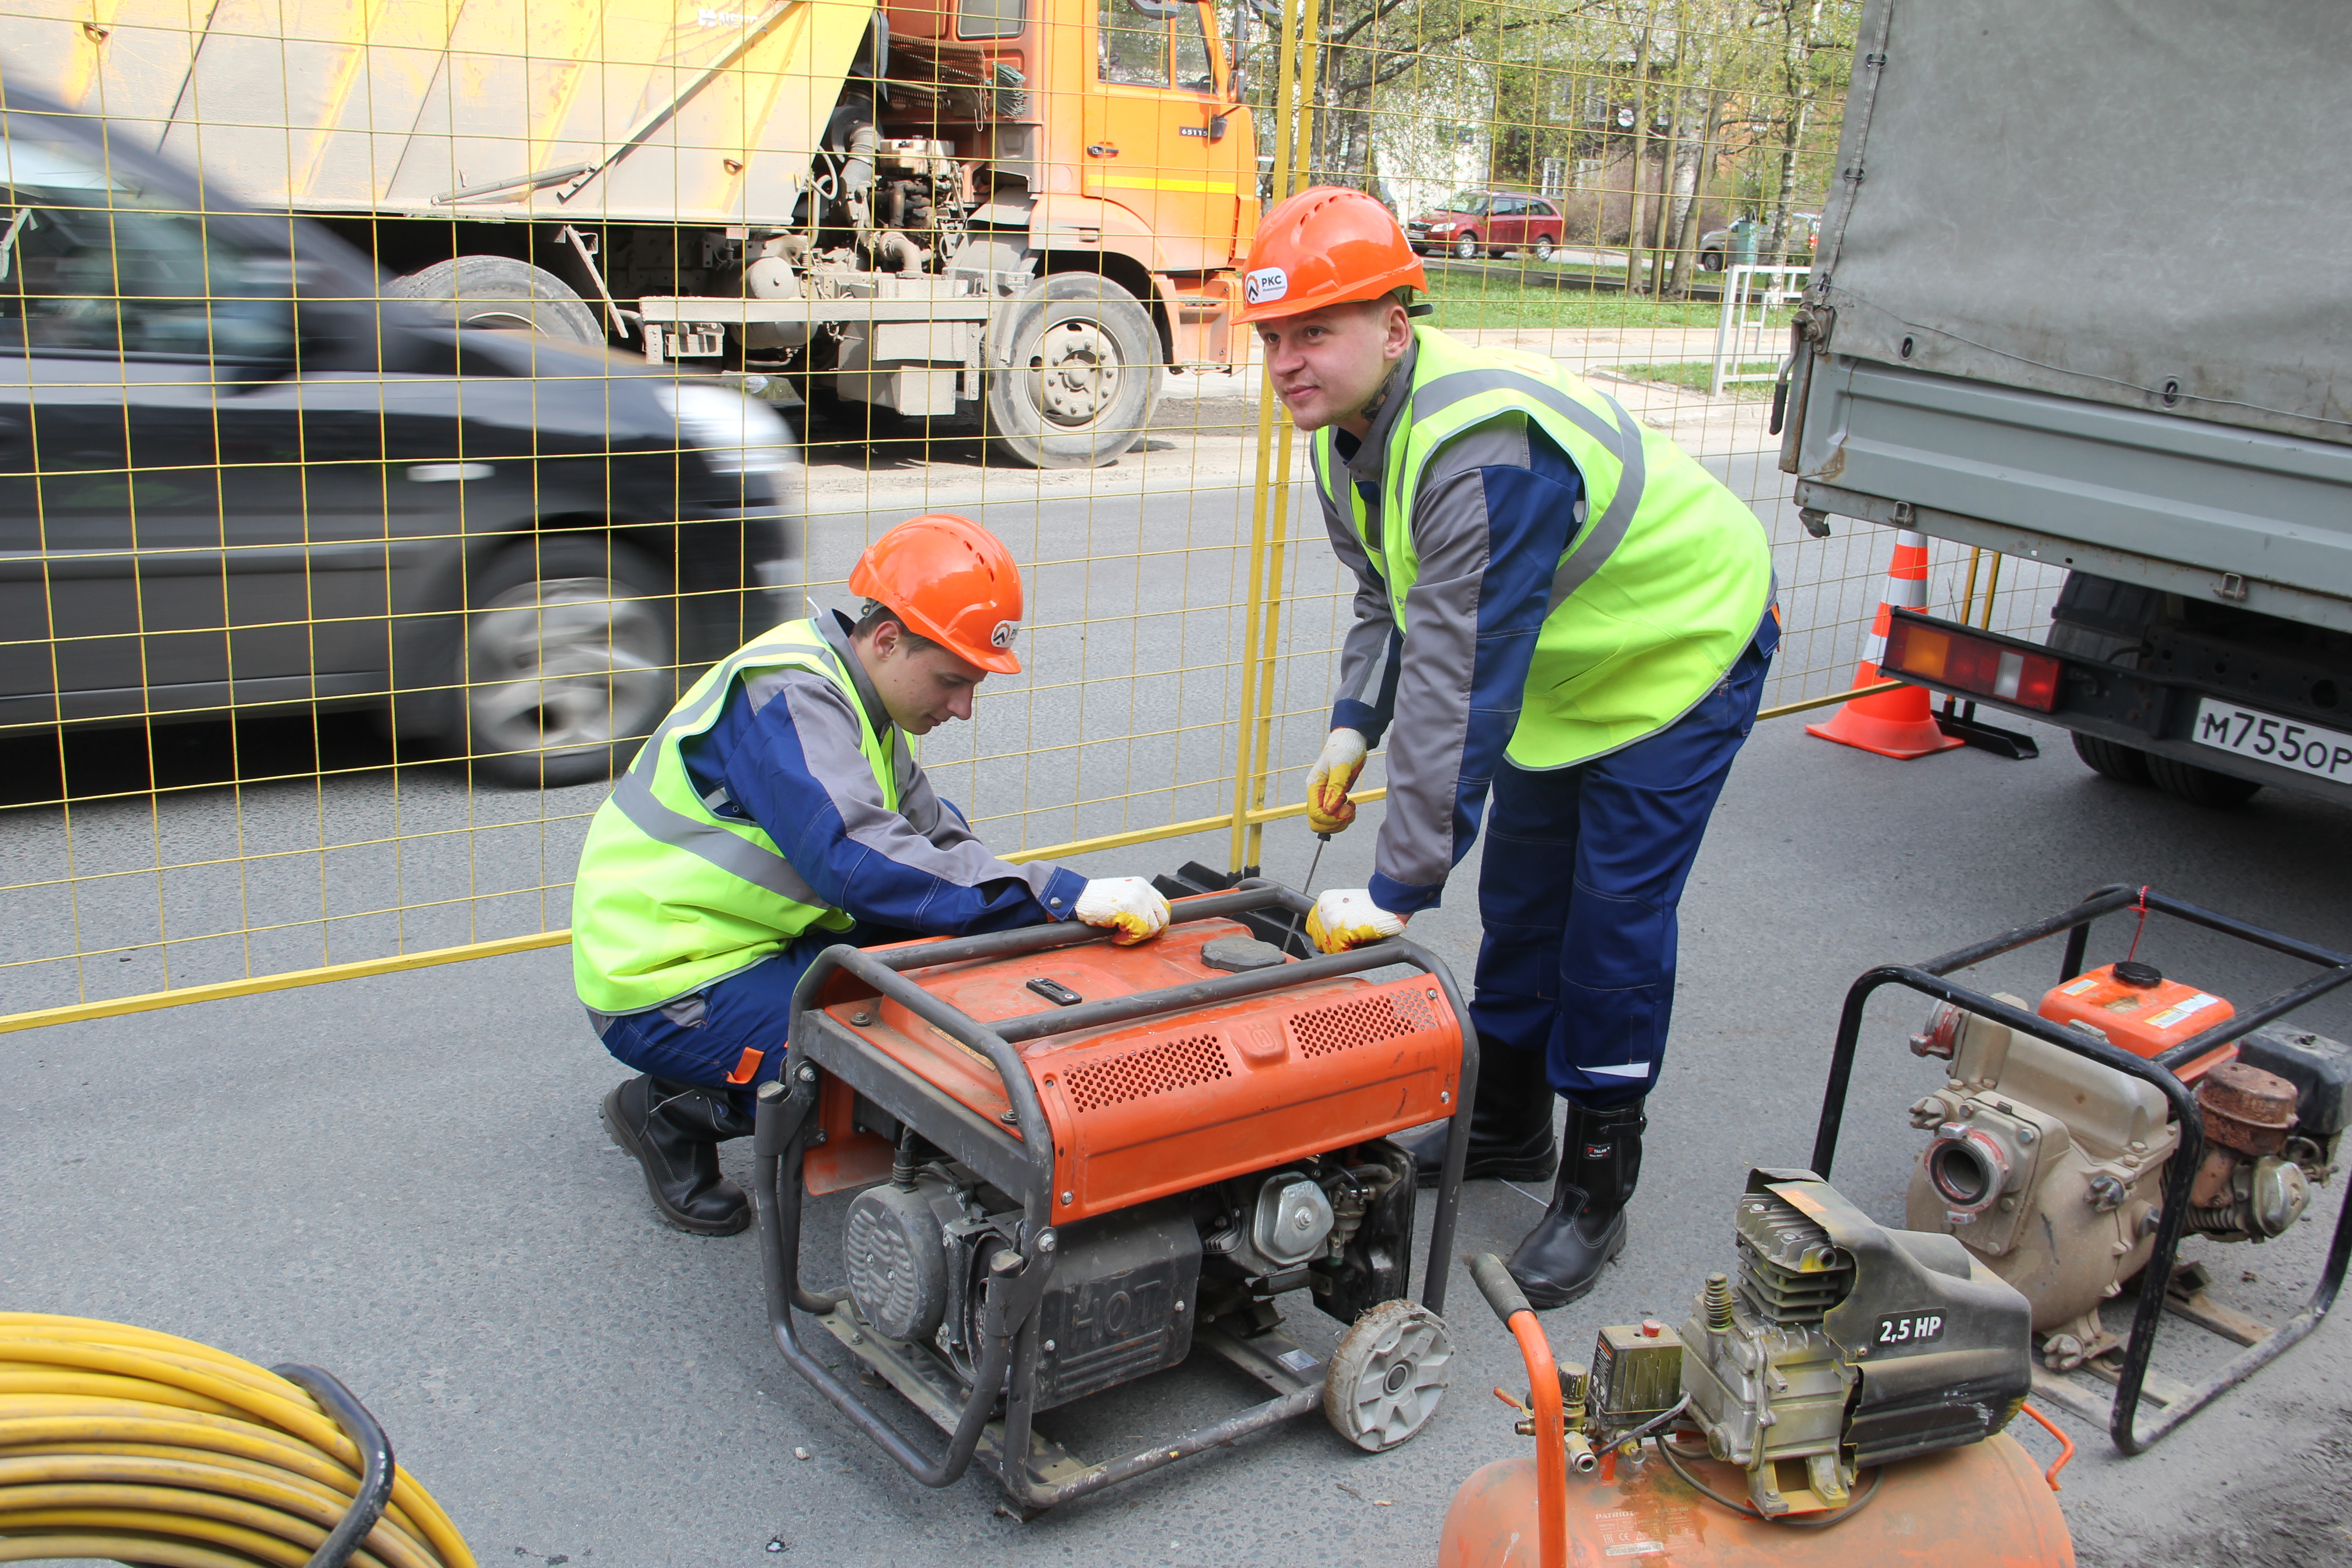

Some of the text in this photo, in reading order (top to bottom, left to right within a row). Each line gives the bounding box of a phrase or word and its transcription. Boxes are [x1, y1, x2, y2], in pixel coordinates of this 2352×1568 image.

[1262, 275, 1282, 287] РКС
[2203, 711, 2352, 774] М755ОР
[1070, 1280, 1161, 1350] HOT
[1880, 1316, 1941, 1343] 2,5 HP
[1595, 1511, 1634, 1519] PATRIOT
